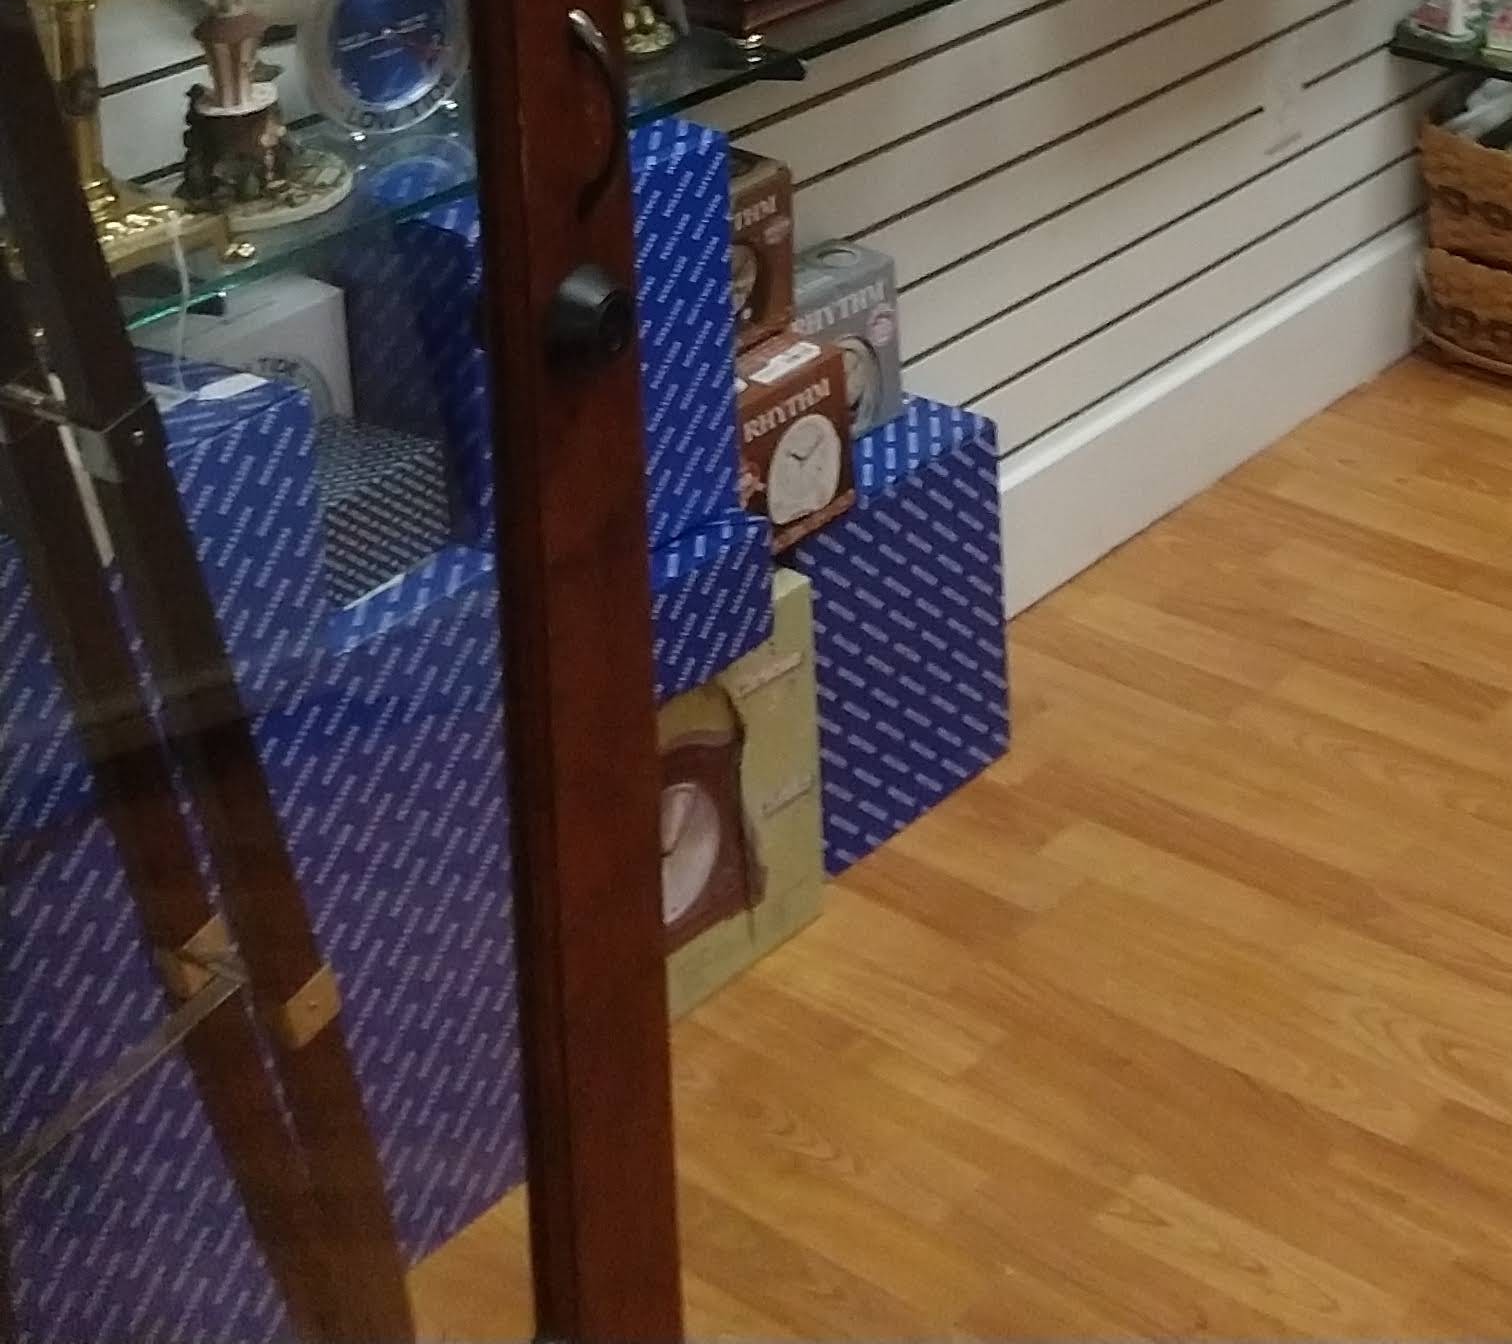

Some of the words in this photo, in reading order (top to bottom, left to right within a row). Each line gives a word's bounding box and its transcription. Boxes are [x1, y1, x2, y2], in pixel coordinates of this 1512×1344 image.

[733, 195, 778, 232] THM
[789, 280, 887, 338] RHYTHM
[743, 377, 831, 444] RHYTHM
